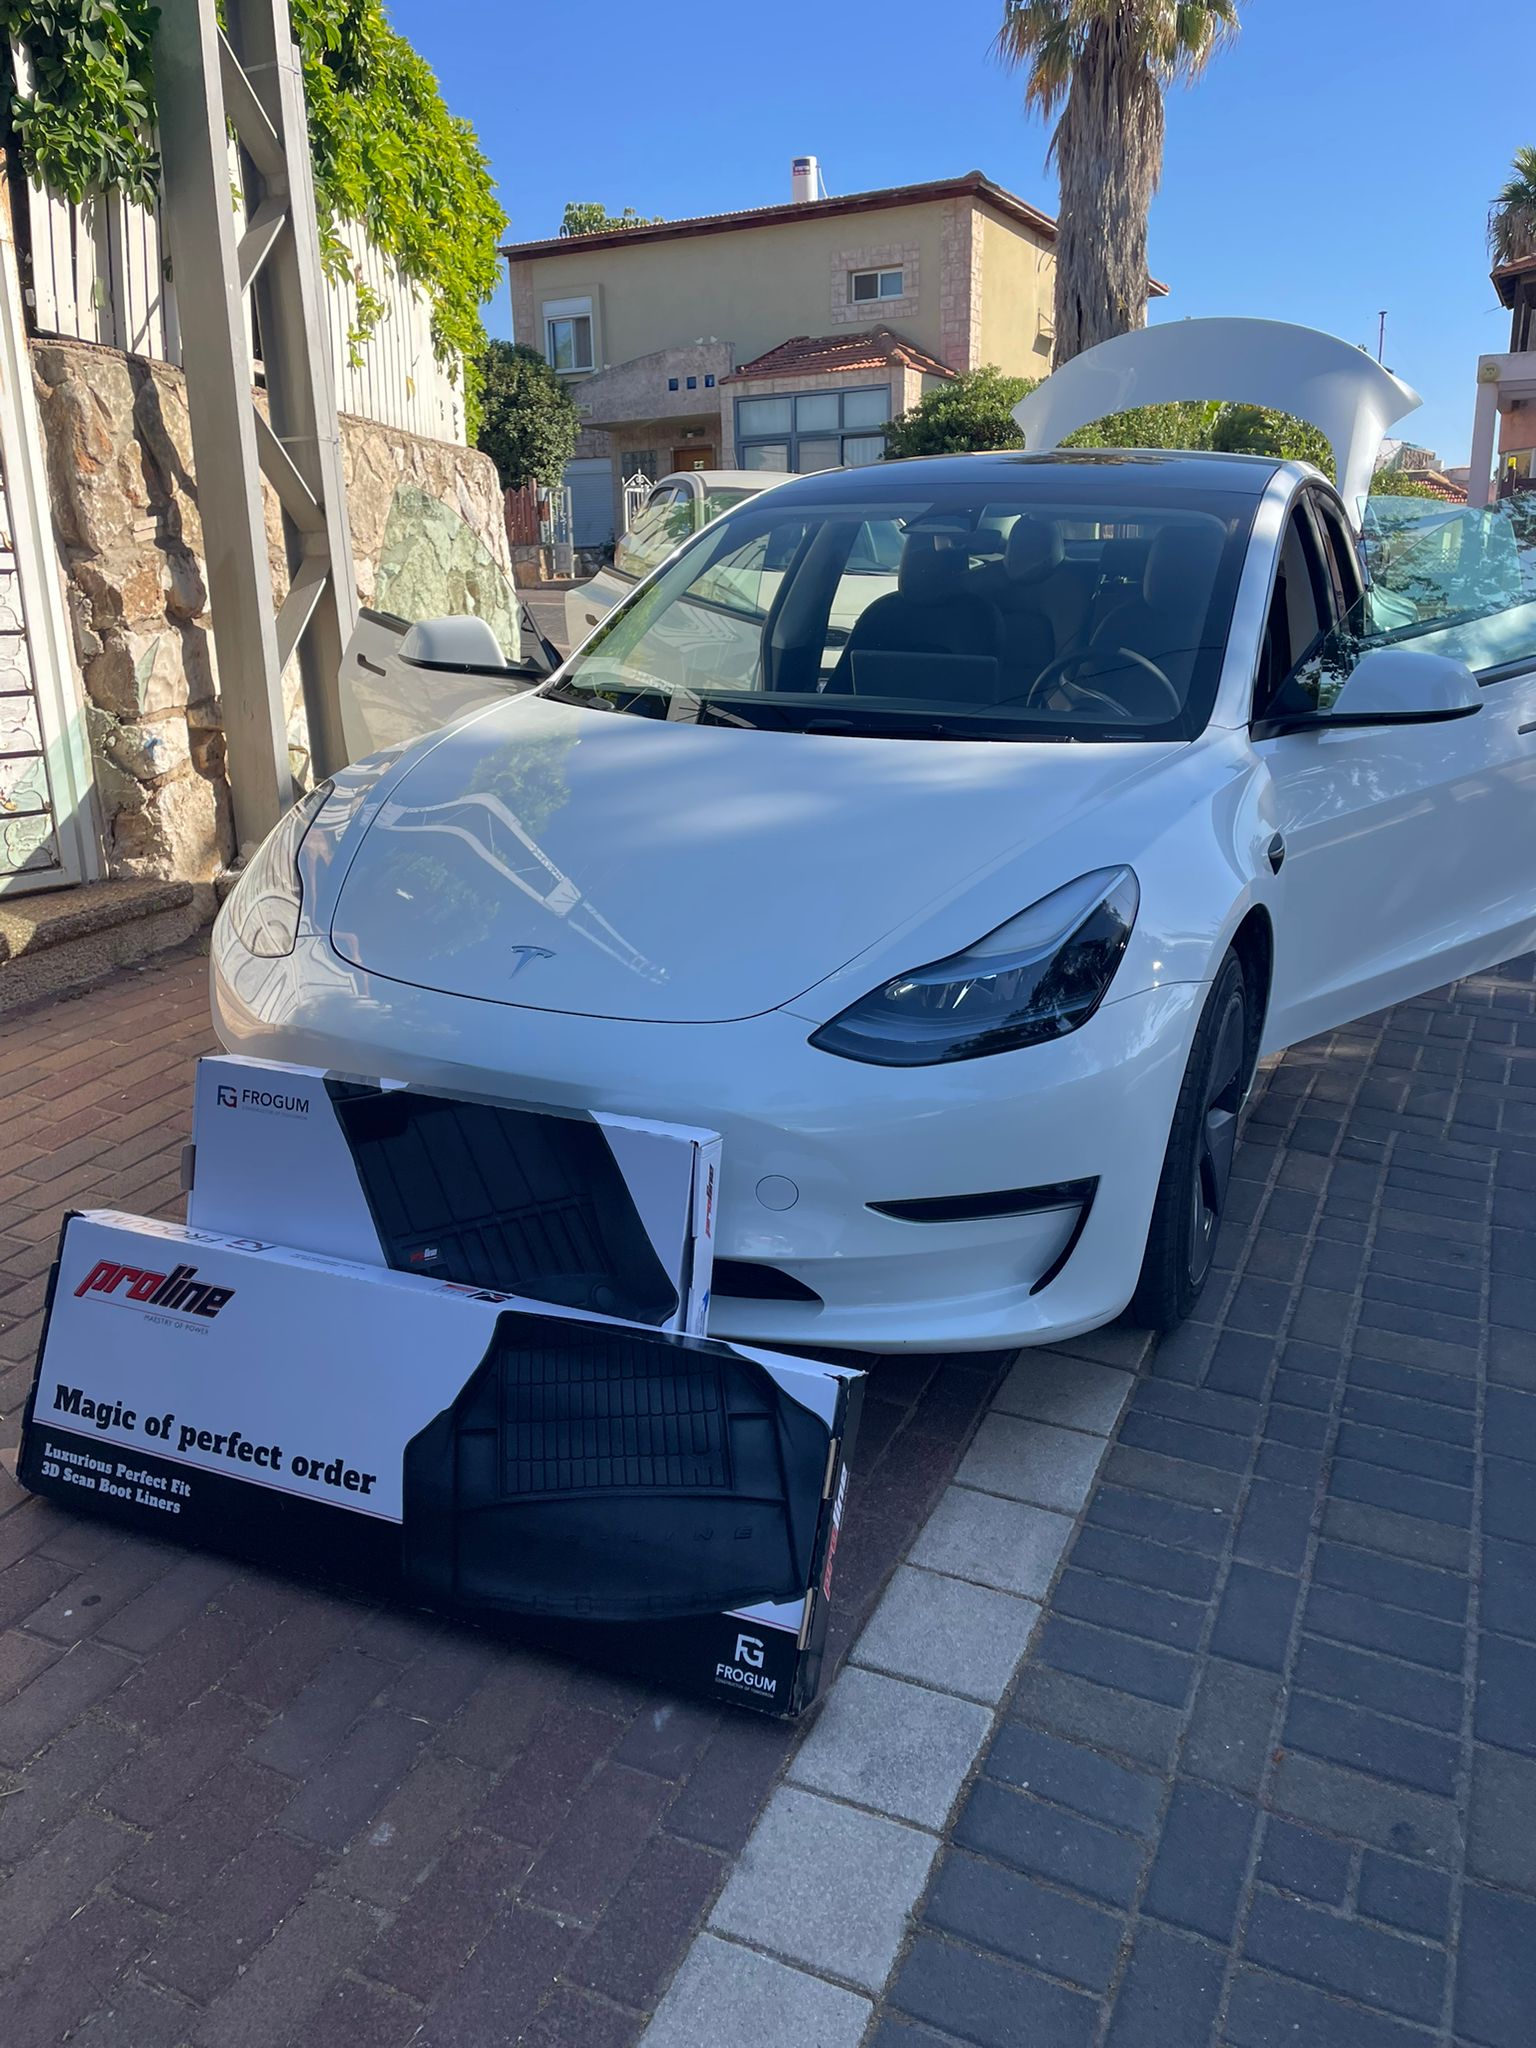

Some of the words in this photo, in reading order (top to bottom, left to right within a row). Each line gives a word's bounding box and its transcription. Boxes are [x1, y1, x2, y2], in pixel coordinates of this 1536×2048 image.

[242, 1089, 309, 1113] FROGUM
[101, 1213, 223, 1245] FROGUM
[74, 1259, 236, 1318] proline
[175, 1321, 183, 1329] OF
[185, 1323, 209, 1335] POWER
[53, 1384, 136, 1430] Magic
[144, 1414, 174, 1440] of
[177, 1422, 282, 1471] perfect
[291, 1454, 376, 1495] order
[41, 1461, 59, 1479] 3D
[62, 1467, 96, 1490] Scan
[99, 1478, 132, 1500] Boot
[135, 1488, 181, 1514] Liners
[44, 1443, 113, 1475] Luxurious
[116, 1463, 168, 1492] Perfect
[170, 1480, 191, 1498] Fit
[823, 1461, 849, 1602] proline
[716, 1663, 777, 1693] FROGUM
